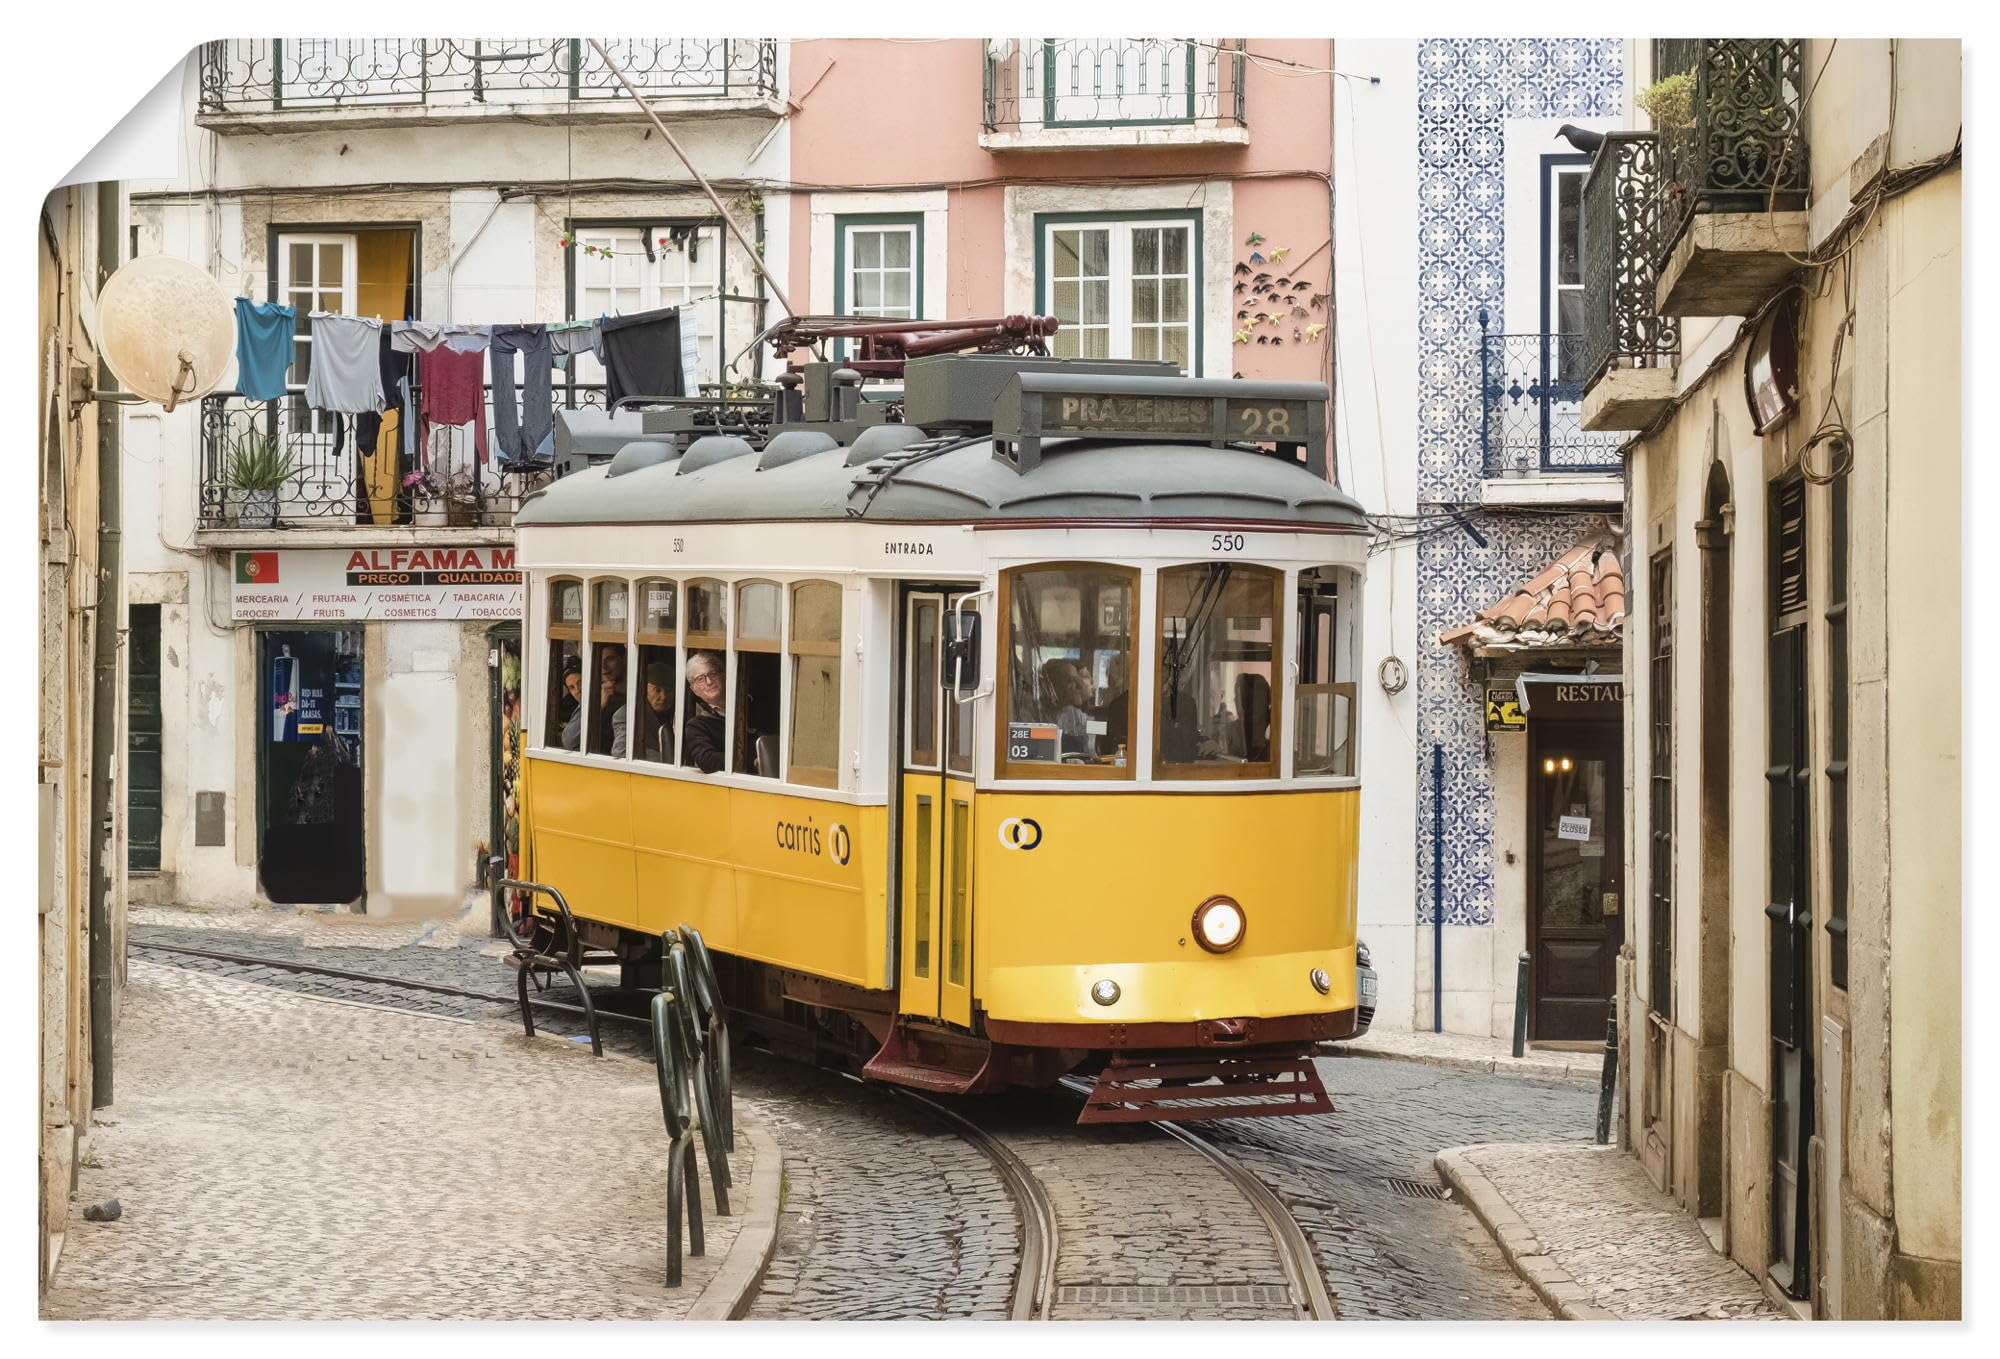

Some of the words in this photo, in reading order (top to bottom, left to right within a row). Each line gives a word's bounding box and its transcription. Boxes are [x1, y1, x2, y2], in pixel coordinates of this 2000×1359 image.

[1241, 408, 1291, 436] 28
[673, 538, 684, 552] 550
[885, 542, 933, 555] ENTRADA
[1212, 534, 1244, 551] 550
[346, 550, 483, 570] ALFAMA
[358, 573, 410, 585] PREÇO
[437, 572, 522, 584] QUALIDADE
[235, 595, 289, 604] MERCEARIA
[312, 594, 357, 603] FRUTARIA
[378, 592, 431, 602] COSMÉTICA
[453, 593, 505, 602] TABACARIA
[236, 609, 280, 618] GROCERY
[313, 609, 345, 617] FRUITS
[384, 608, 437, 617] COSMETICS
[471, 607, 522, 616] TOBACCOS
[1012, 730, 1029, 739] 28E
[1011, 745, 1028, 757] 03
[776, 816, 821, 856] carris
